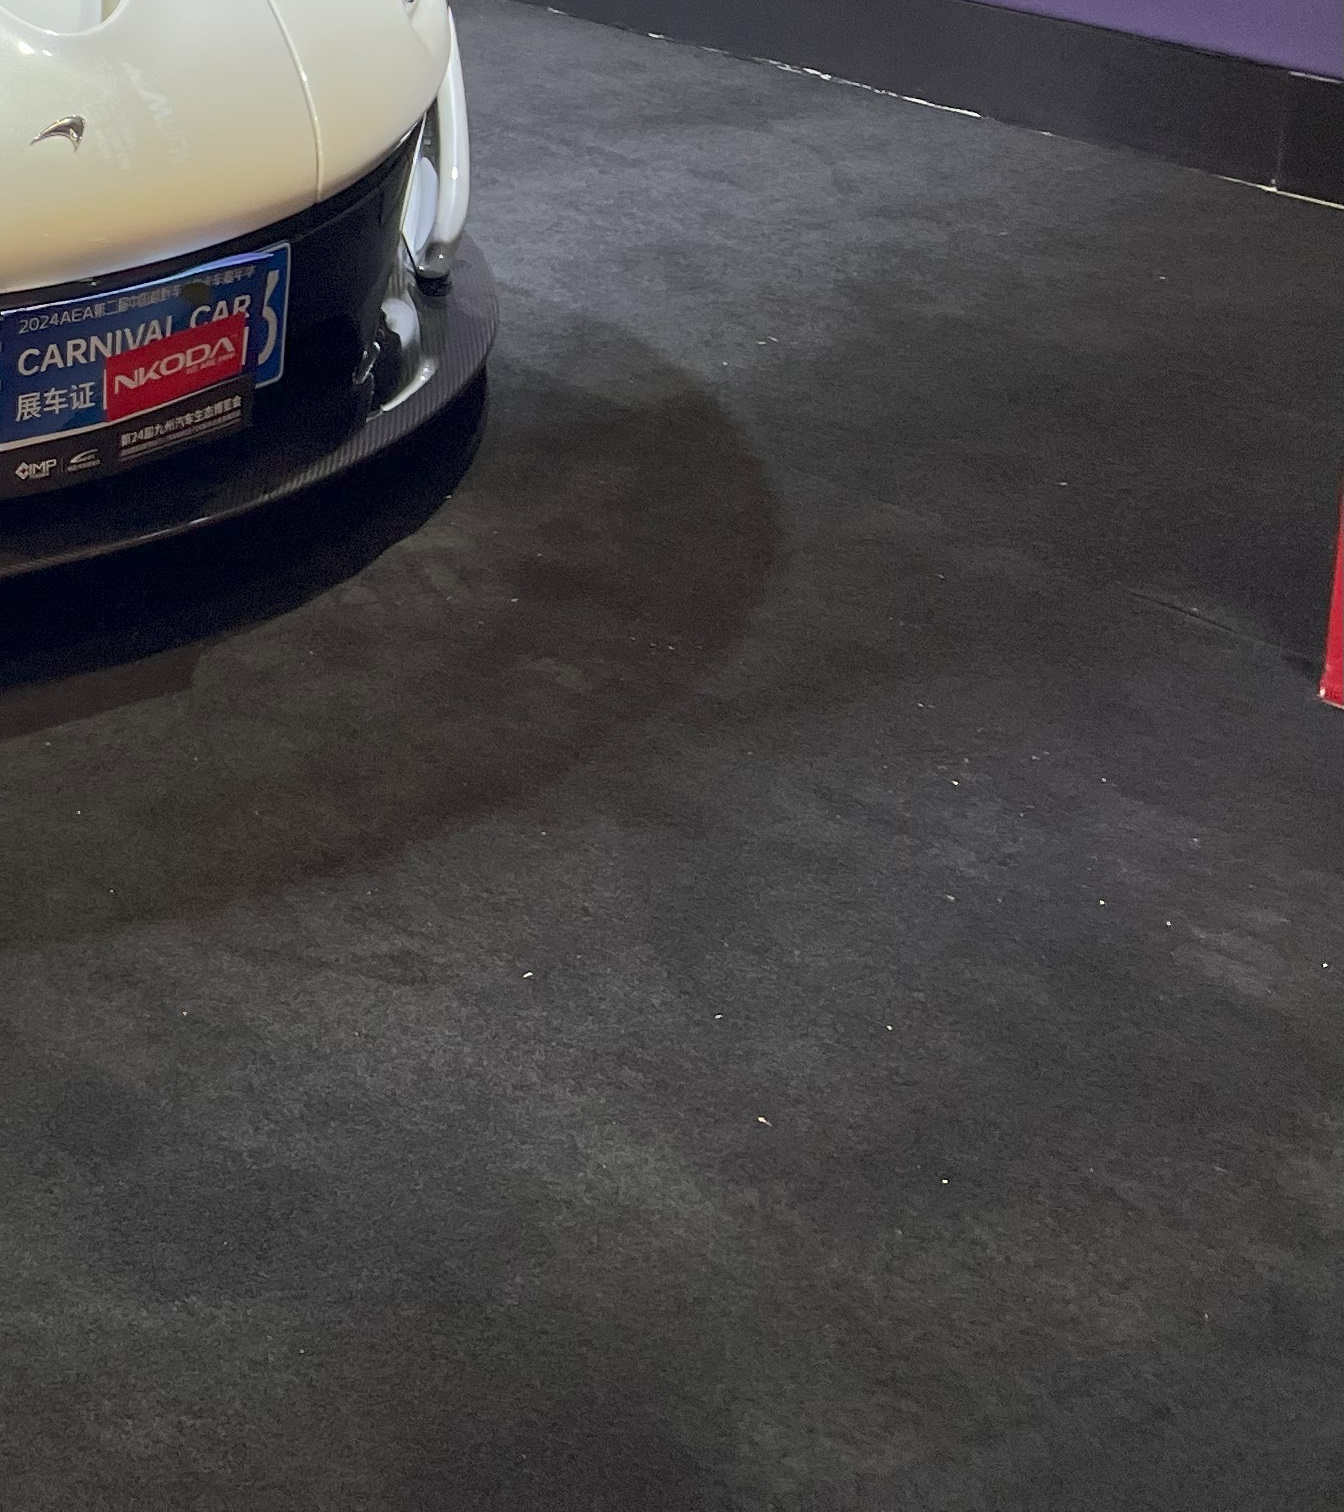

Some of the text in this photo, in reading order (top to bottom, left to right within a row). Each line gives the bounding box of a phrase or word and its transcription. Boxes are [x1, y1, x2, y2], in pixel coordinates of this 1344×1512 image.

[190, 295, 251, 328] CAR
[114, 337, 235, 394] NKODA
[15, 382, 96, 422] 展车证
